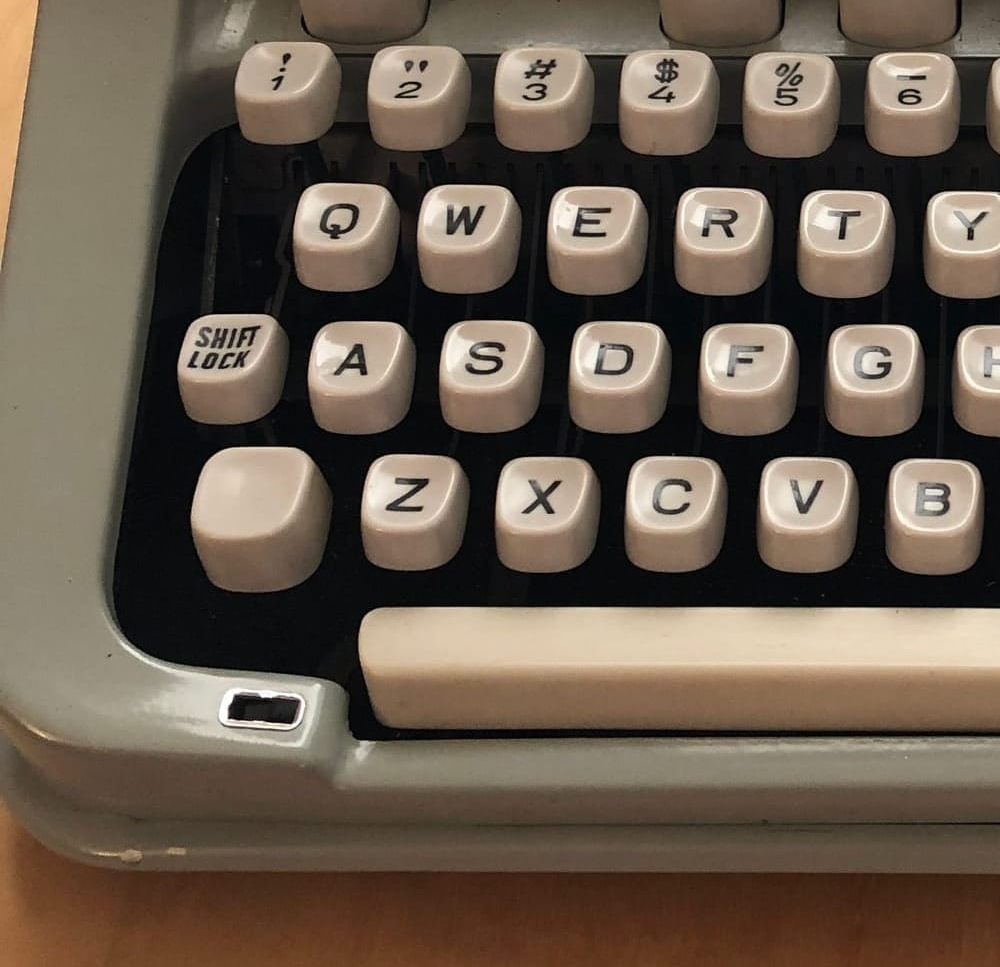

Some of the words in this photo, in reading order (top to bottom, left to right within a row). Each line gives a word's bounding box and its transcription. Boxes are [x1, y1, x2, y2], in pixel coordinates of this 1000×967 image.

[523, 58, 558, 81] #
[653, 57, 680, 84] $
[774, 61, 804, 88] %
[393, 80, 423, 99] 2
[521, 82, 548, 102] 3
[647, 85, 676, 104] 4
[773, 87, 799, 107] 5
[897, 88, 923, 106] 6
[319, 203, 360, 240] Q
[445, 204, 486, 236] W
[571, 207, 612, 238] E
[700, 208, 739, 239] R
[828, 210, 862, 241] T
[953, 211, 990, 241] Y
[194, 324, 263, 350] SHIFT
[186, 349, 251, 370] LOCK
[332, 343, 369, 377] A
[464, 341, 506, 376] S
[593, 343, 635, 376] D
[726, 345, 765, 378] F
[853, 345, 893, 381] G
[384, 477, 430, 513] Z
[520, 479, 563, 515] X
[652, 478, 693, 516] C
[789, 479, 825, 515] V
[914, 481, 952, 518] B
